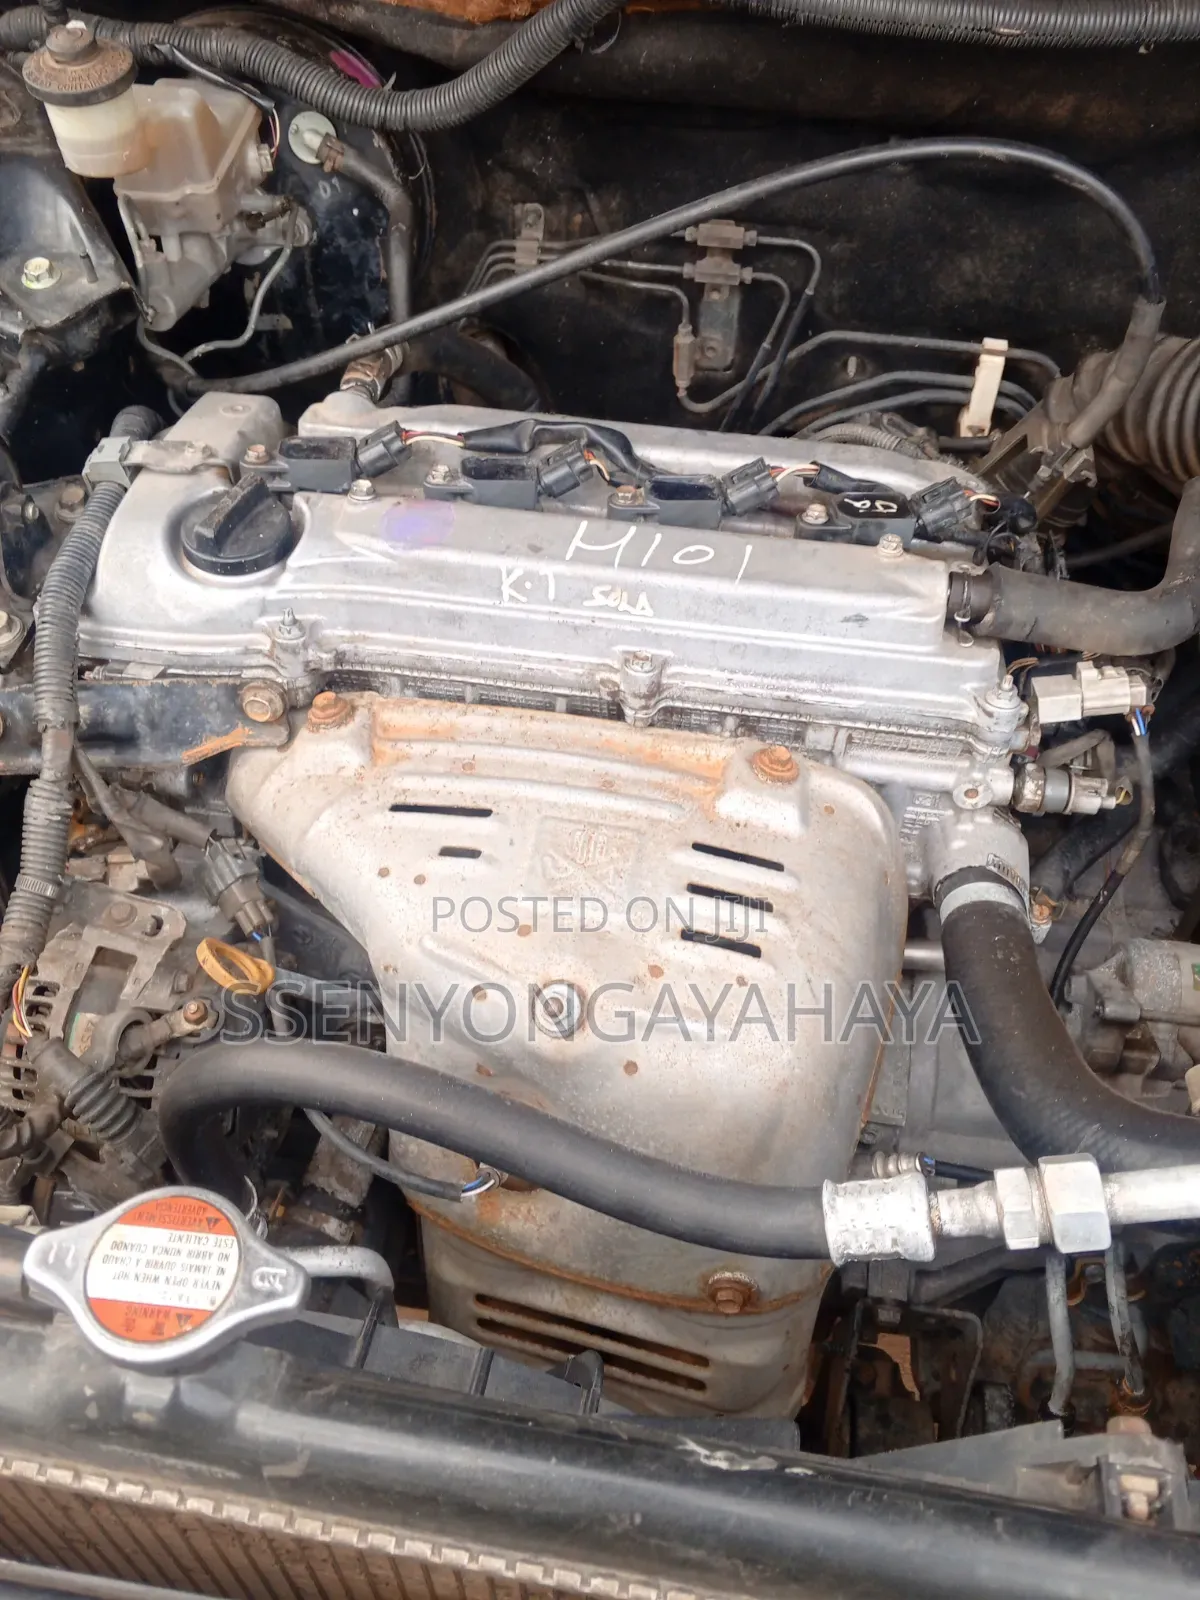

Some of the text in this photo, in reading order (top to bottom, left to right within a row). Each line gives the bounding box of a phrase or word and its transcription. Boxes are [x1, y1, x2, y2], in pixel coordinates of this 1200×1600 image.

[168, 1232, 235, 1249] ESTE CALIENTE
[110, 1240, 231, 1263] NO ABRIR NUNCA CUANDO
[102, 1254, 132, 1267] CHAUD
[145, 1258, 177, 1270] OUVRIR
[181, 1262, 213, 1274] JAMAIS
[216, 1265, 227, 1276] NE
[112, 1270, 221, 1291] NEVER OPEN WHEN HOT
